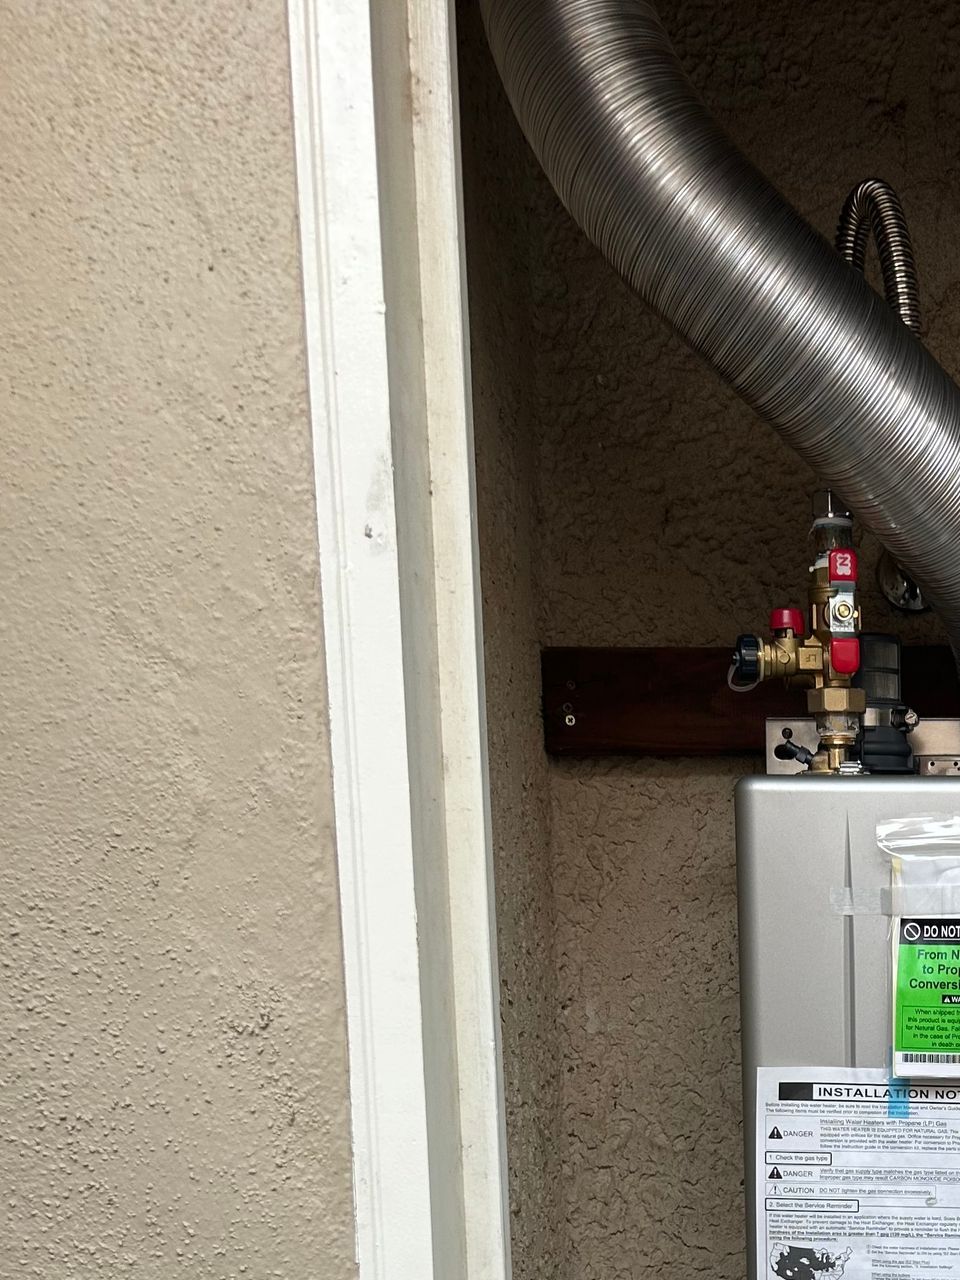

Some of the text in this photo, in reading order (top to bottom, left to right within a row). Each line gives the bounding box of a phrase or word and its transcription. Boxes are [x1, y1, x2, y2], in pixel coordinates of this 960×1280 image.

[924, 926, 938, 937] DO
[941, 926, 960, 937] NOT
[917, 949, 947, 959] From
[922, 964, 934, 974] to
[818, 1087, 929, 1099] INSTALLATION
